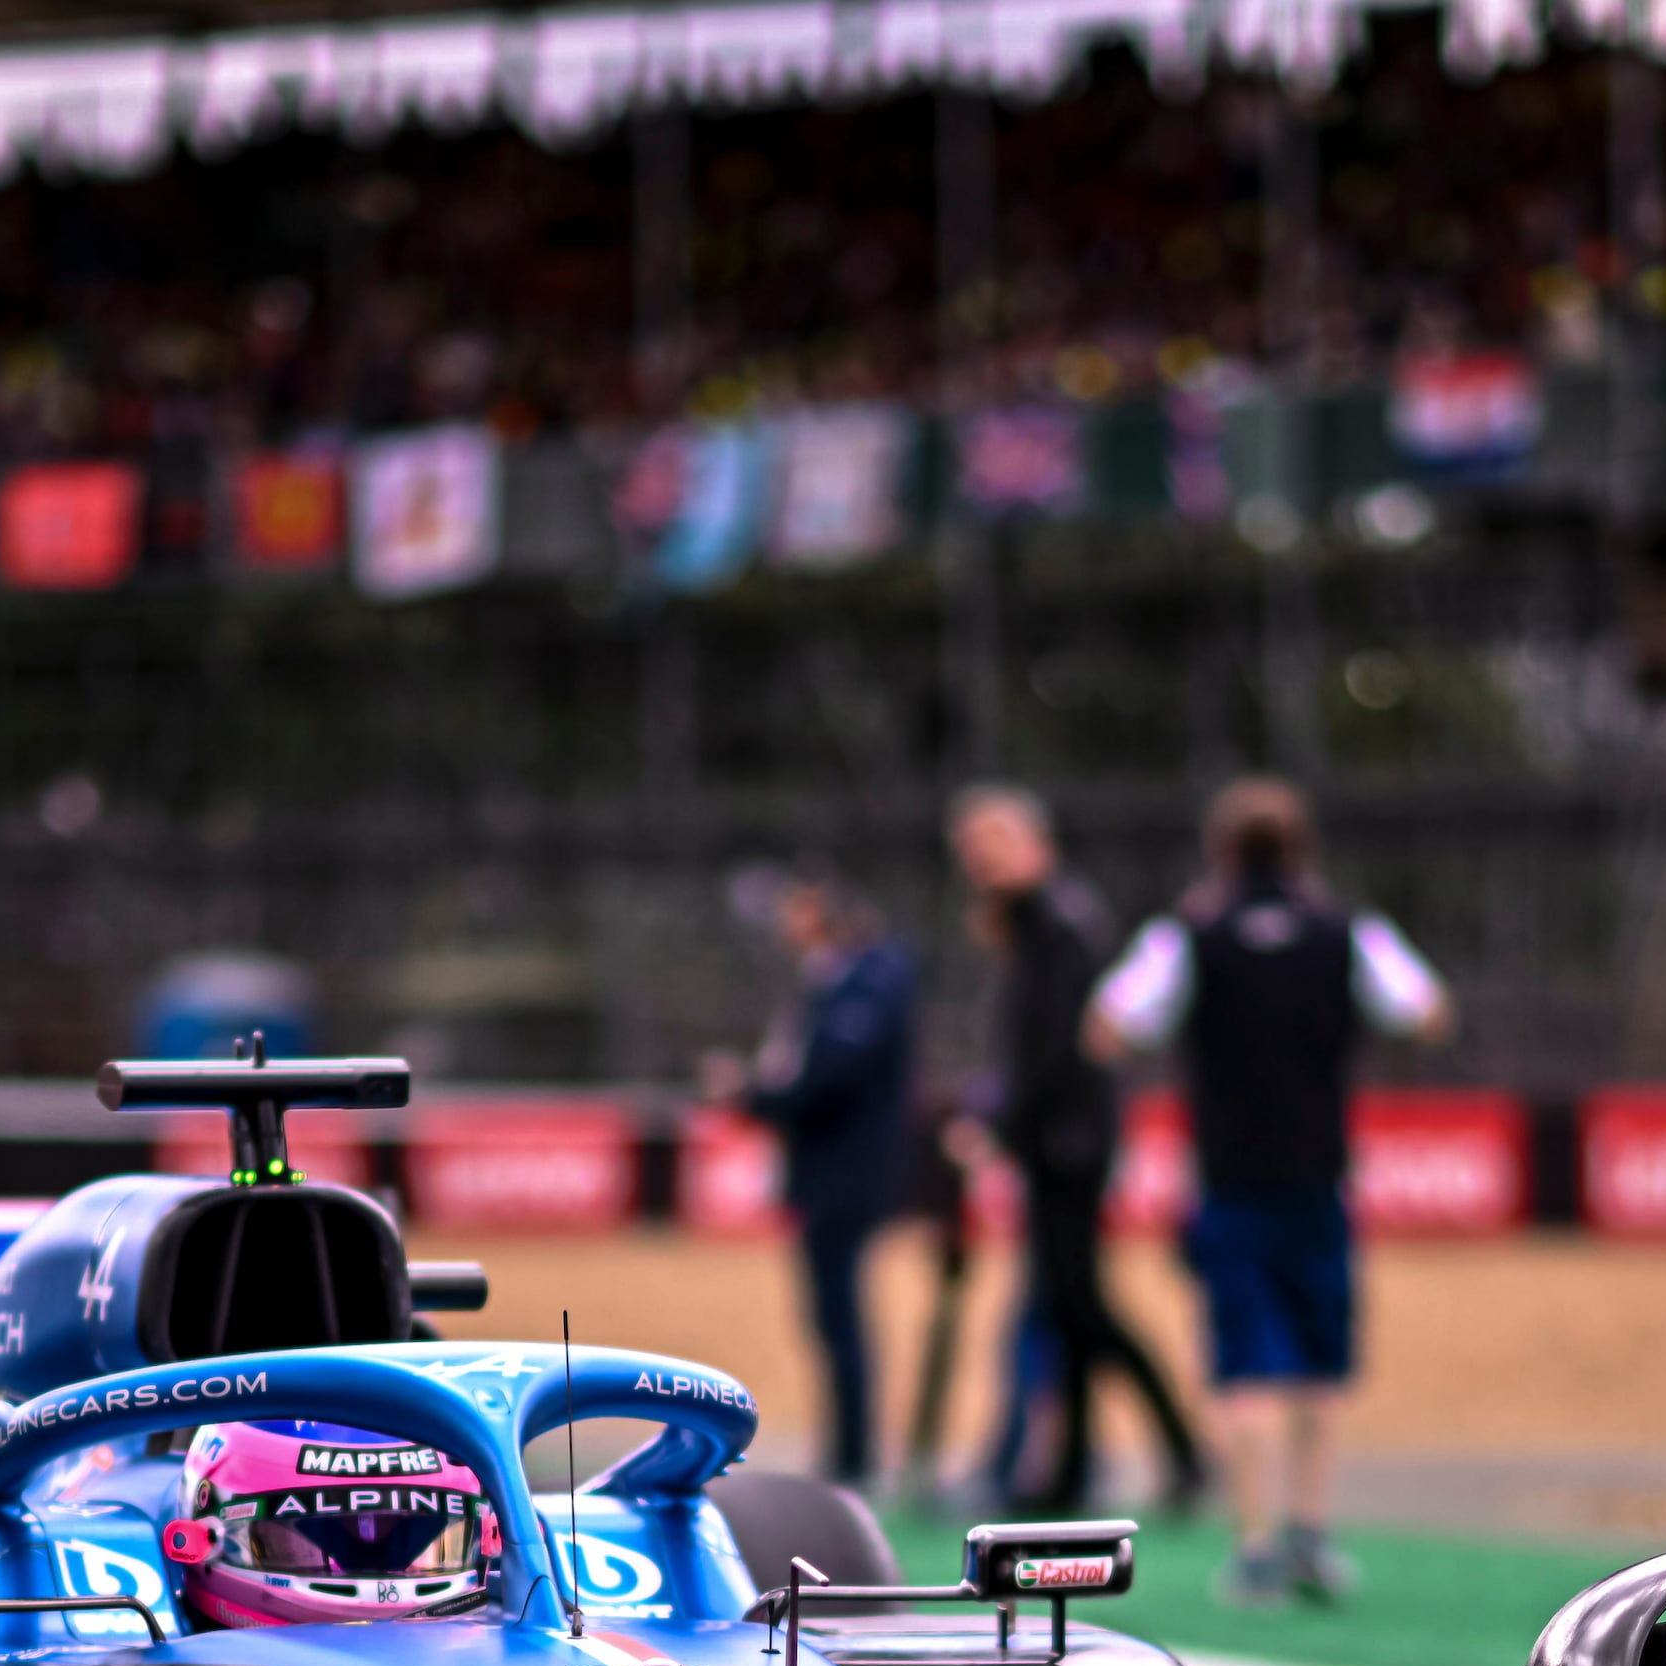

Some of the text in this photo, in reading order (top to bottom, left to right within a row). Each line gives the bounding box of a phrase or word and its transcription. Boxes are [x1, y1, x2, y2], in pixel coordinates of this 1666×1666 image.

[301, 1449, 439, 1473] MAPFRE
[275, 1489, 466, 1516] ALPINE
[1039, 1561, 1106, 1585] Castrol
